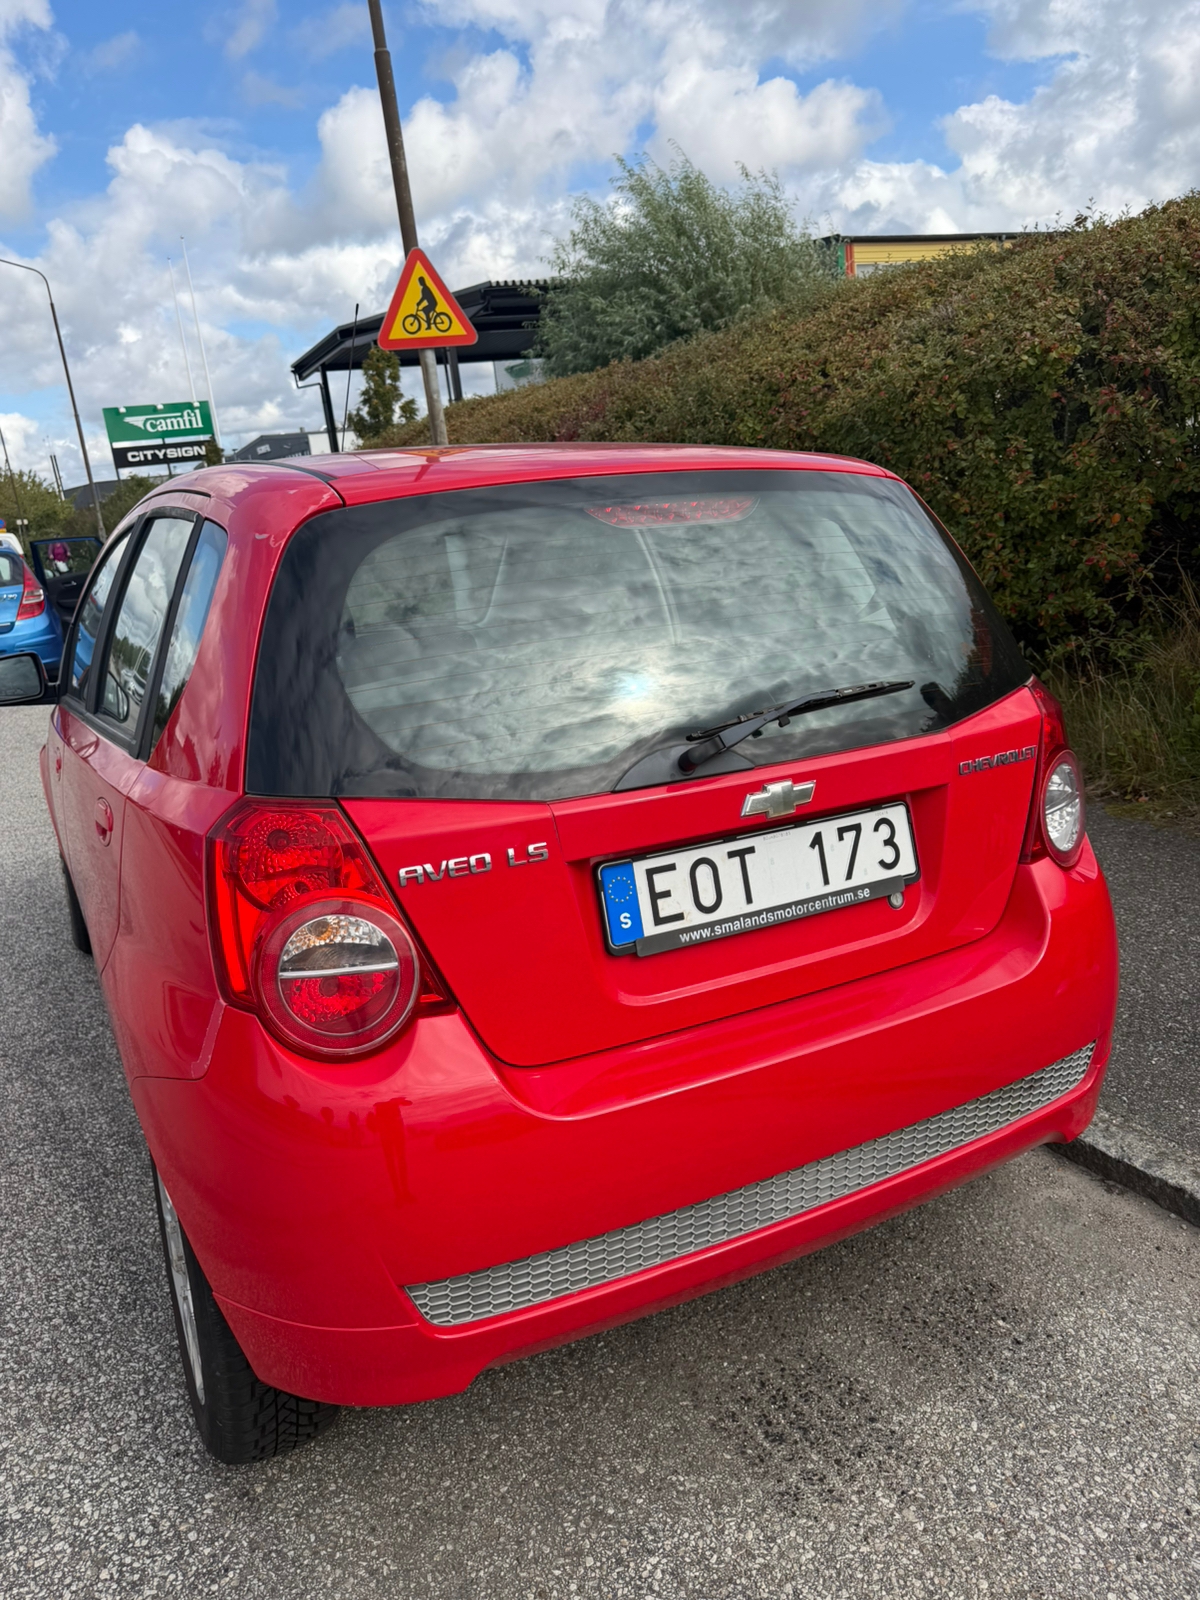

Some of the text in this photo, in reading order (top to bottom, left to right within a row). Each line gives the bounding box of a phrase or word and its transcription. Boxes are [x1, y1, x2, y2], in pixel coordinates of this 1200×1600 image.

[145, 409, 204, 432] camfil
[127, 445, 206, 462] CITYSIGN
[958, 745, 1037, 776] CHEVROLET
[398, 842, 549, 887] AVEO LS
[619, 817, 902, 929] S EOT 173
[680, 887, 871, 943] www.smalandsmotorcentrum.se
